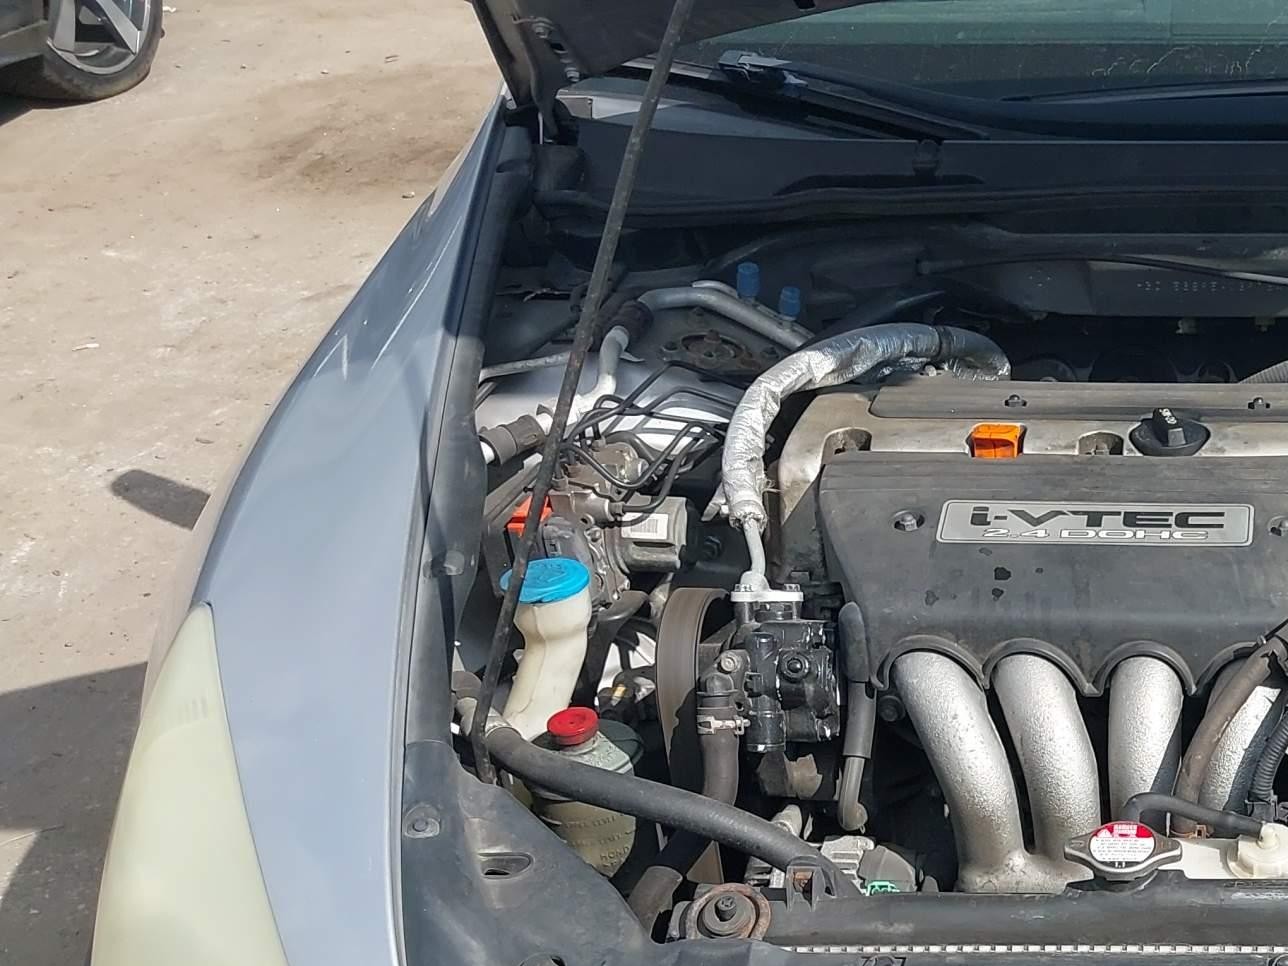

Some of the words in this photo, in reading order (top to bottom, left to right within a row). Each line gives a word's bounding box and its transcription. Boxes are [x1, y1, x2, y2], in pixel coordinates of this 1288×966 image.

[970, 506, 1226, 528] i-VTEC
[983, 528, 1050, 538] 2.4
[1060, 528, 1209, 539] DOHC
